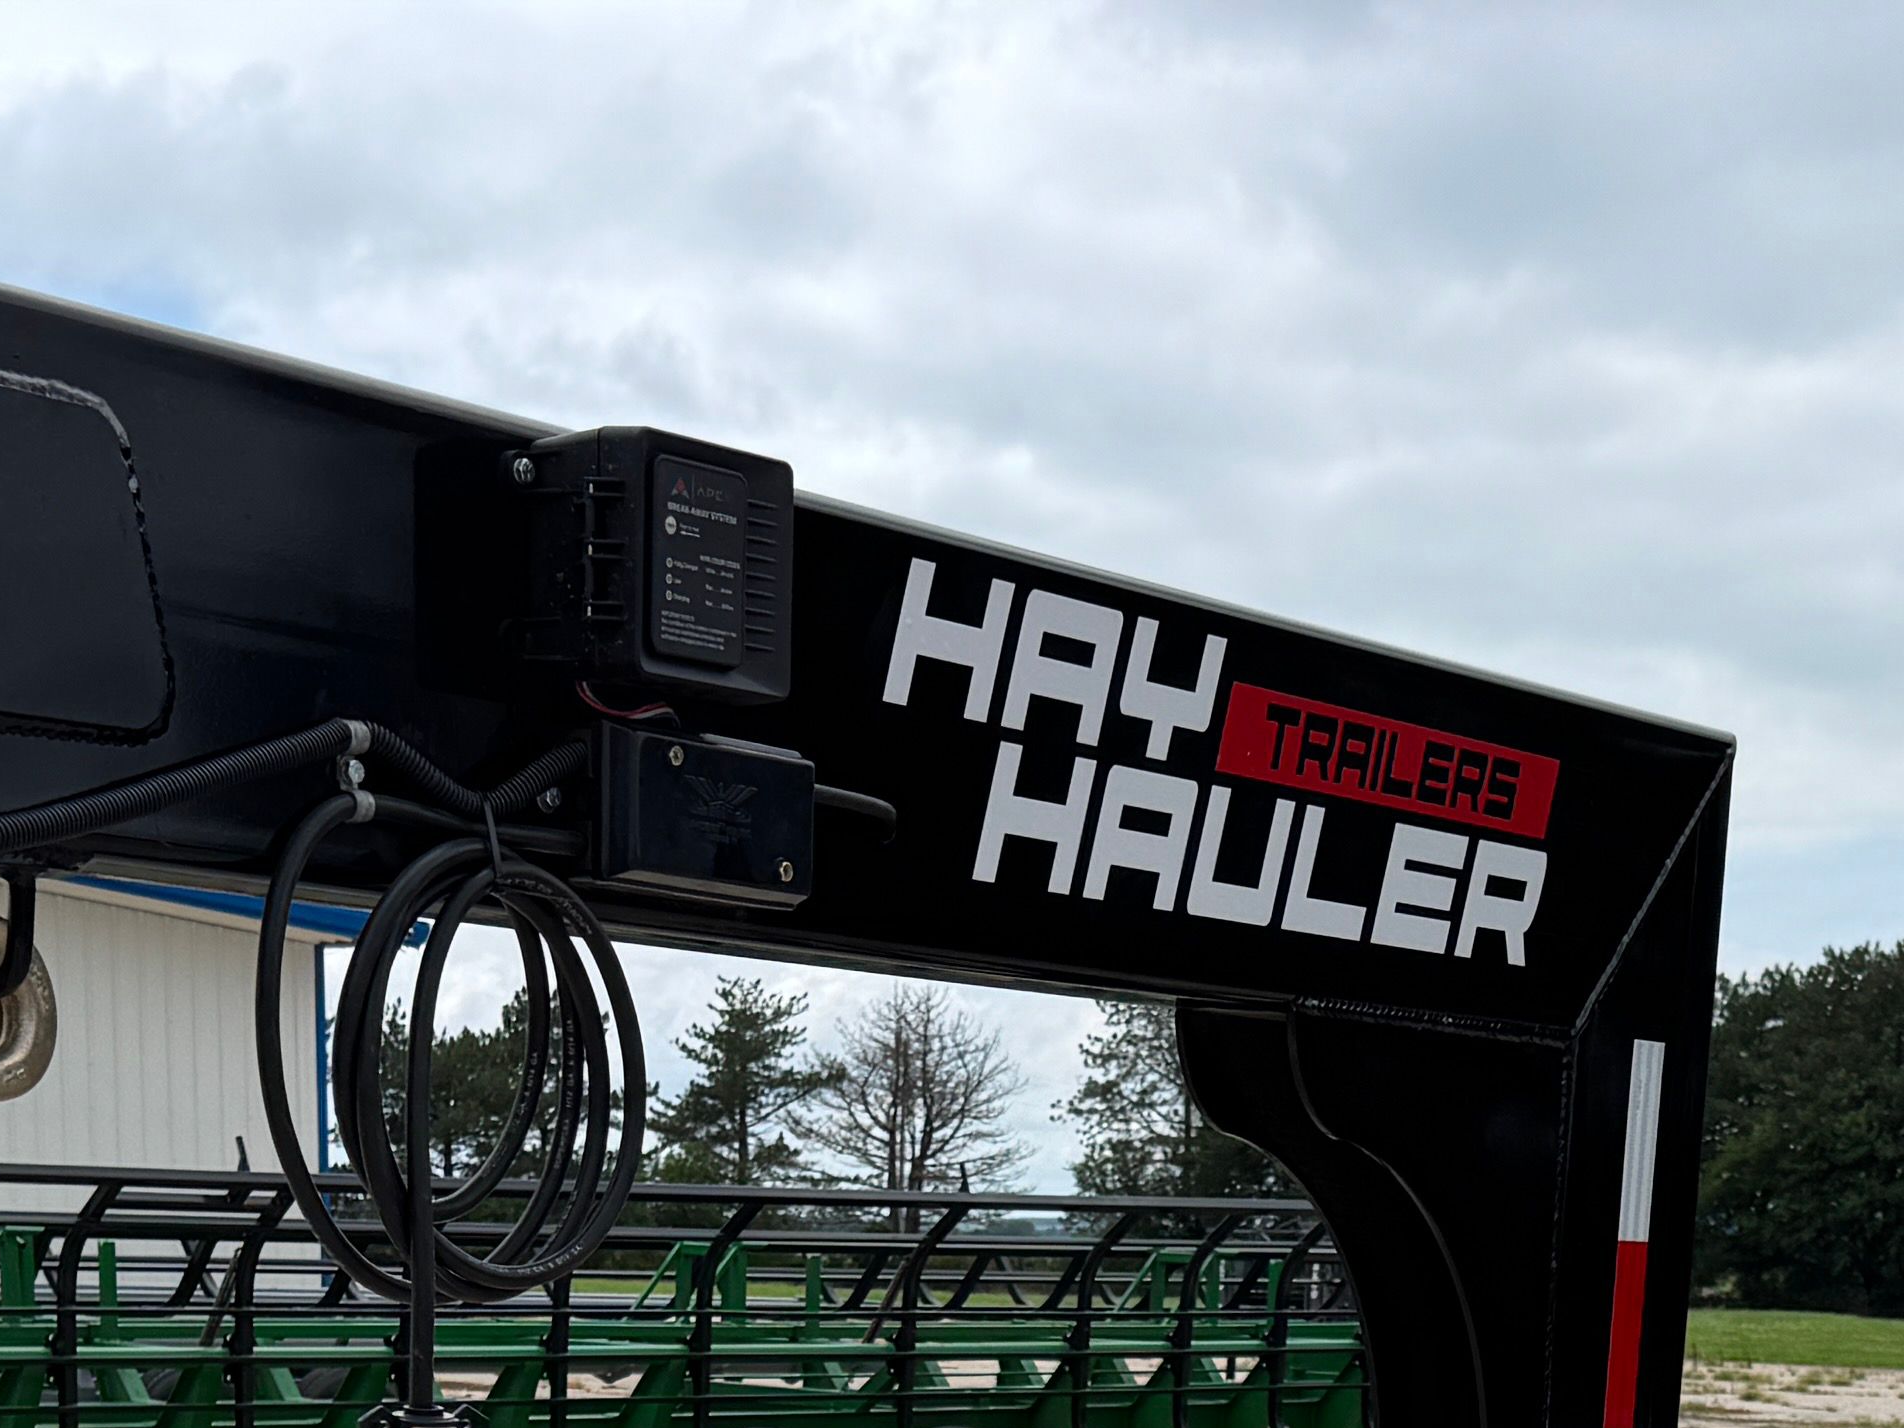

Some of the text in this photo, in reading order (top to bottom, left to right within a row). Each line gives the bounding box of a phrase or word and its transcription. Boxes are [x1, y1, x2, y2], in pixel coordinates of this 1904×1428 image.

[883, 557, 1228, 760] HAY
[972, 740, 1548, 967] HAULER
[1266, 702, 1521, 821] TRAILERS
